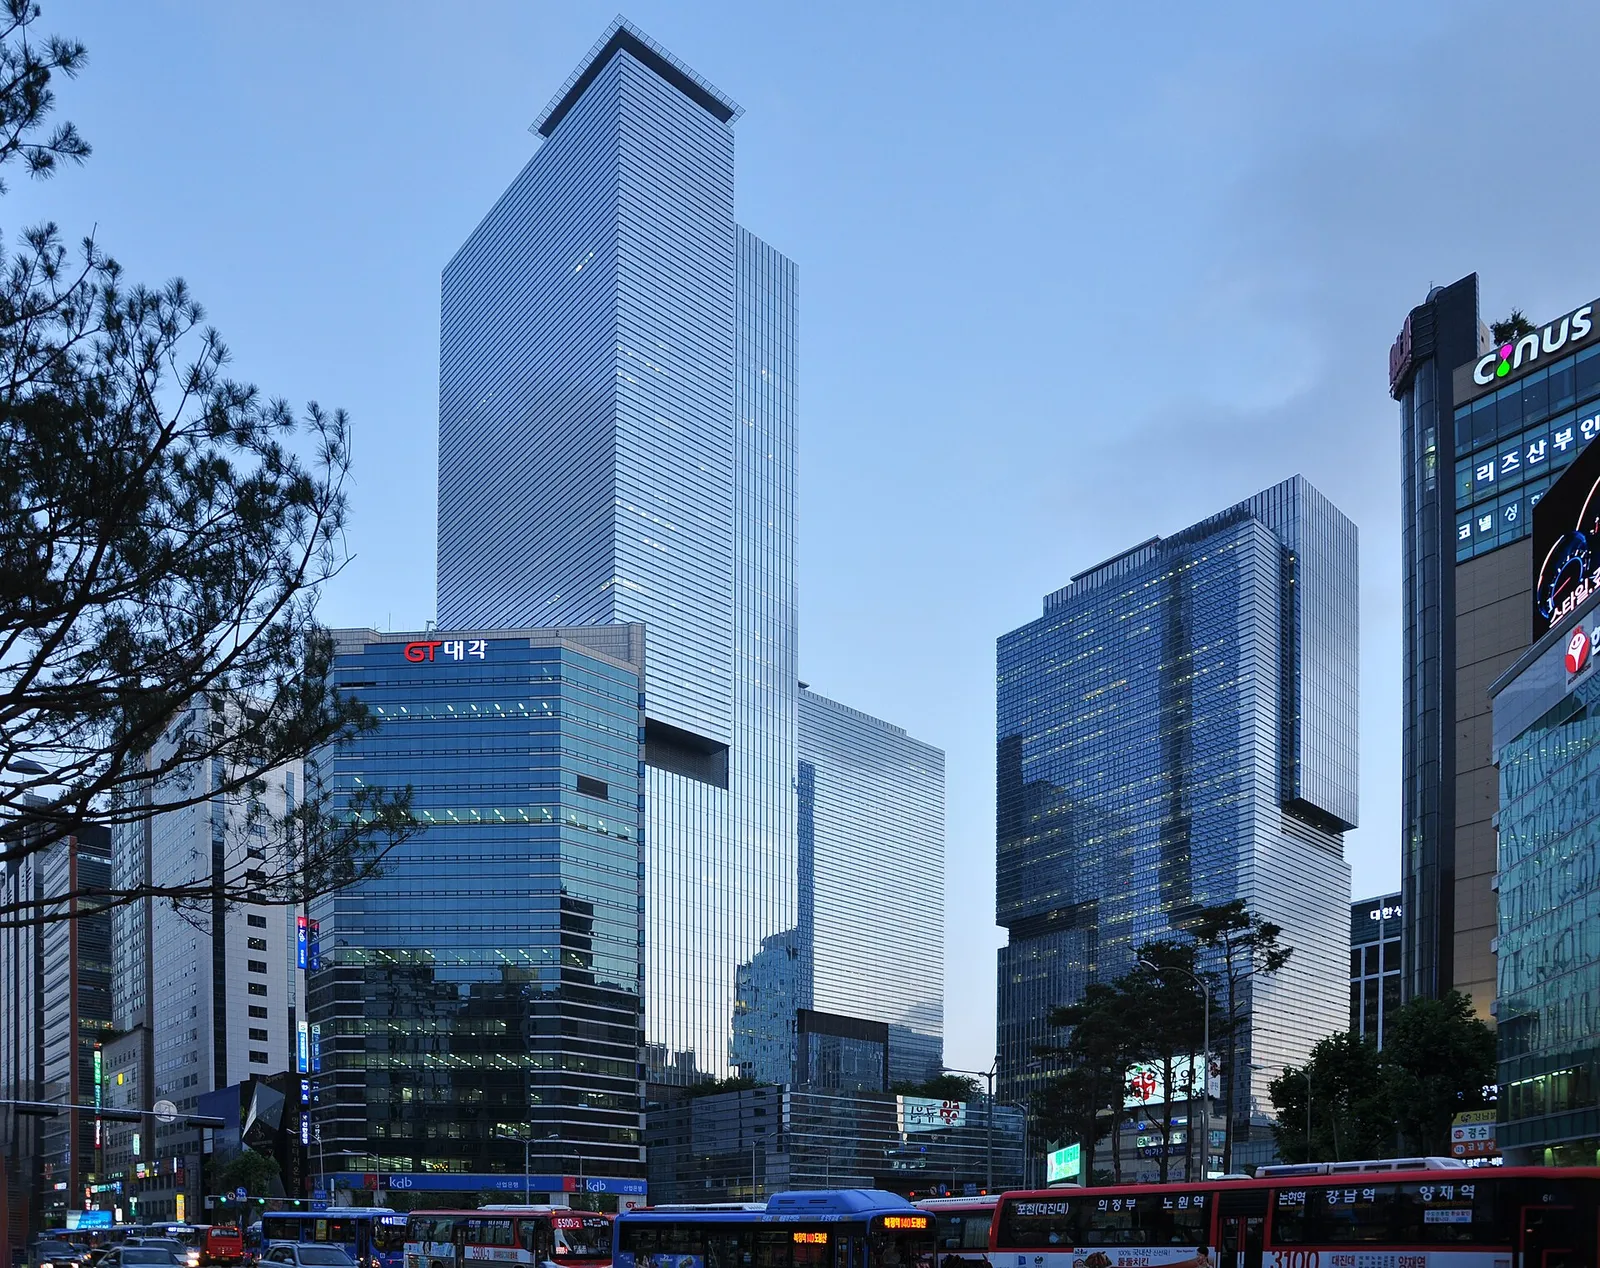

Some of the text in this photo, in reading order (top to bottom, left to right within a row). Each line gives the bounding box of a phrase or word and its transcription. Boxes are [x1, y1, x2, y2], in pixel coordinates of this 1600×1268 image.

[1476, 414, 1600, 482] 리즈산부인
[404, 640, 489, 662] GT 대각
[389, 1176, 519, 1189] kdb 산업은행
[586, 1179, 643, 1193] kdb 산업은행
[1278, 1184, 1475, 1206] 논현역 강남역 양재역
[1016, 1195, 1204, 1216] 포천(대진대) 의정부 노원역
[380, 1217, 393, 1225] 441
[557, 1218, 580, 1228] 5500-2
[1270, 1251, 1319, 1268] 3100
